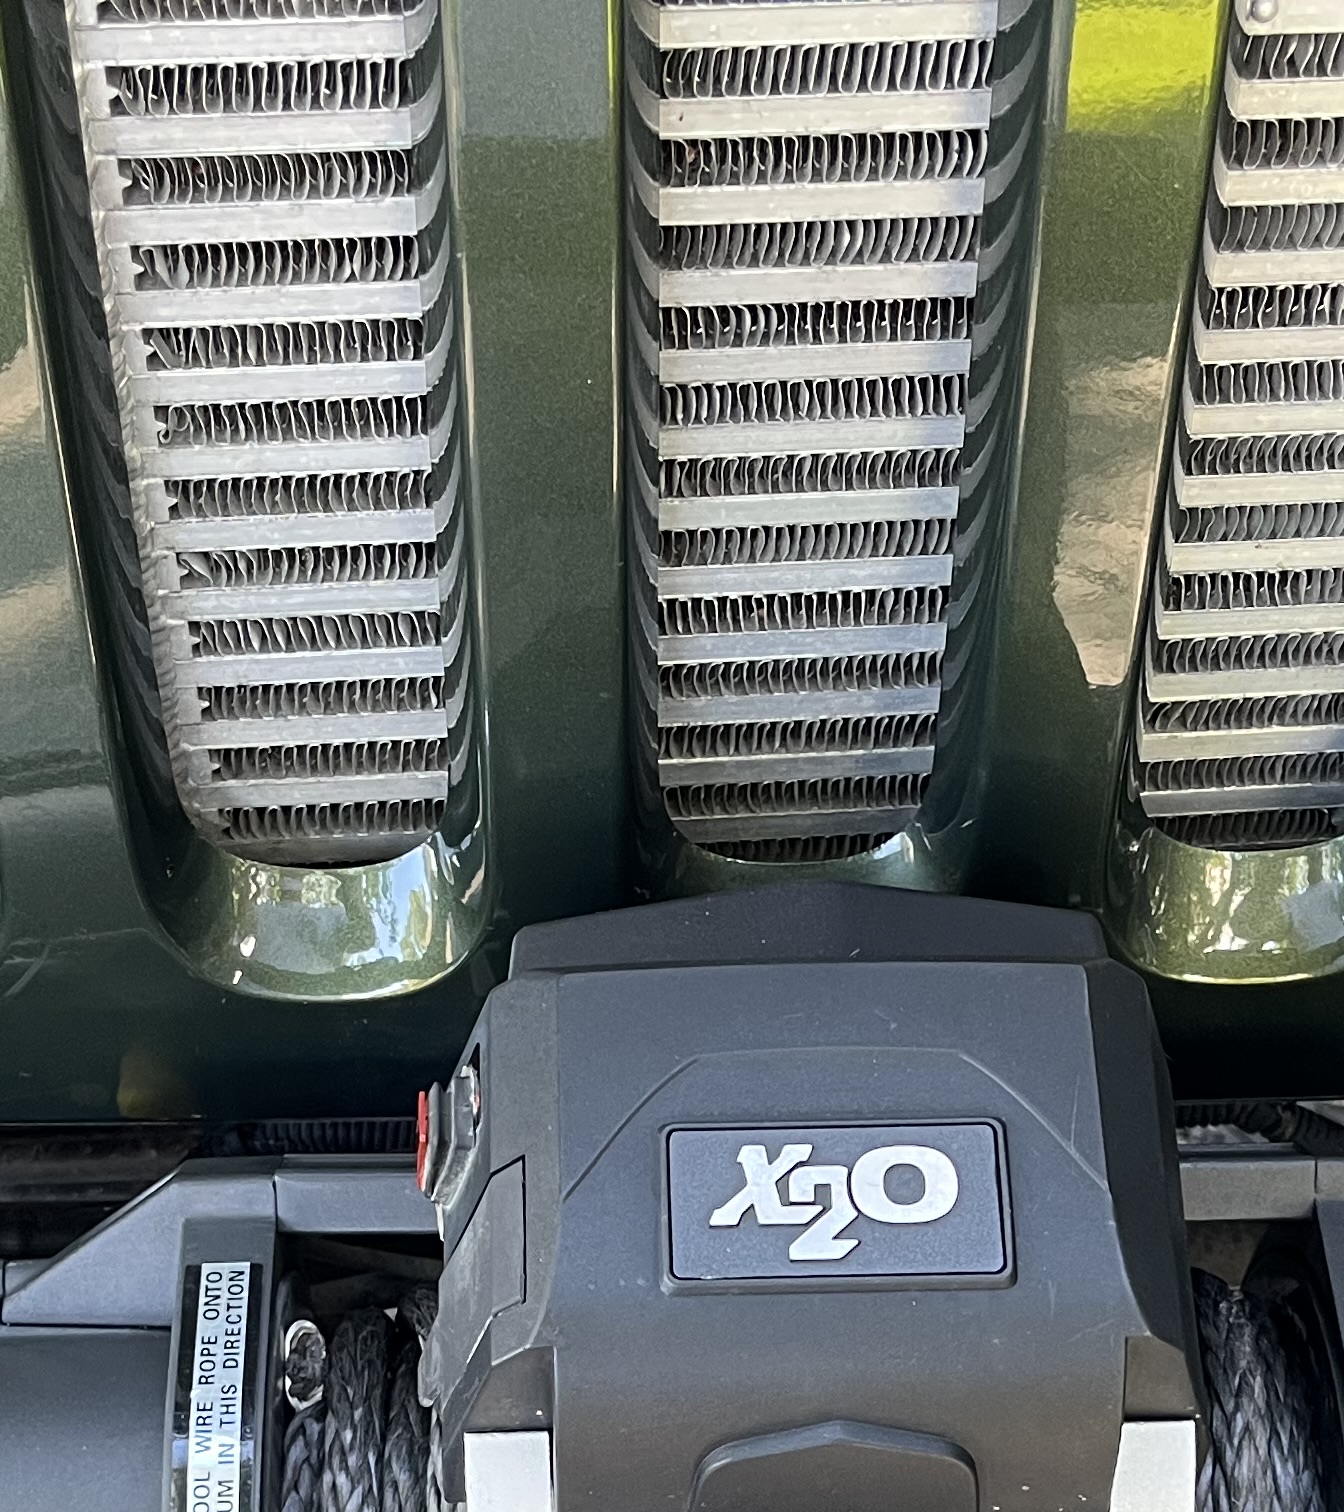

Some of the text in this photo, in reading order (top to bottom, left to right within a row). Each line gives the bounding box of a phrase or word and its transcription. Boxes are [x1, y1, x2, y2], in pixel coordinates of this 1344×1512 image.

[709, 1143, 959, 1261] X2O
[202, 1271, 223, 1321] ONTO
[222, 1270, 246, 1369] DIRECTION
[197, 1335, 218, 1385] ROPE
[194, 1401, 214, 1454] WIRE
[219, 1384, 238, 1429] THIS
[217, 1443, 235, 1465] IN
